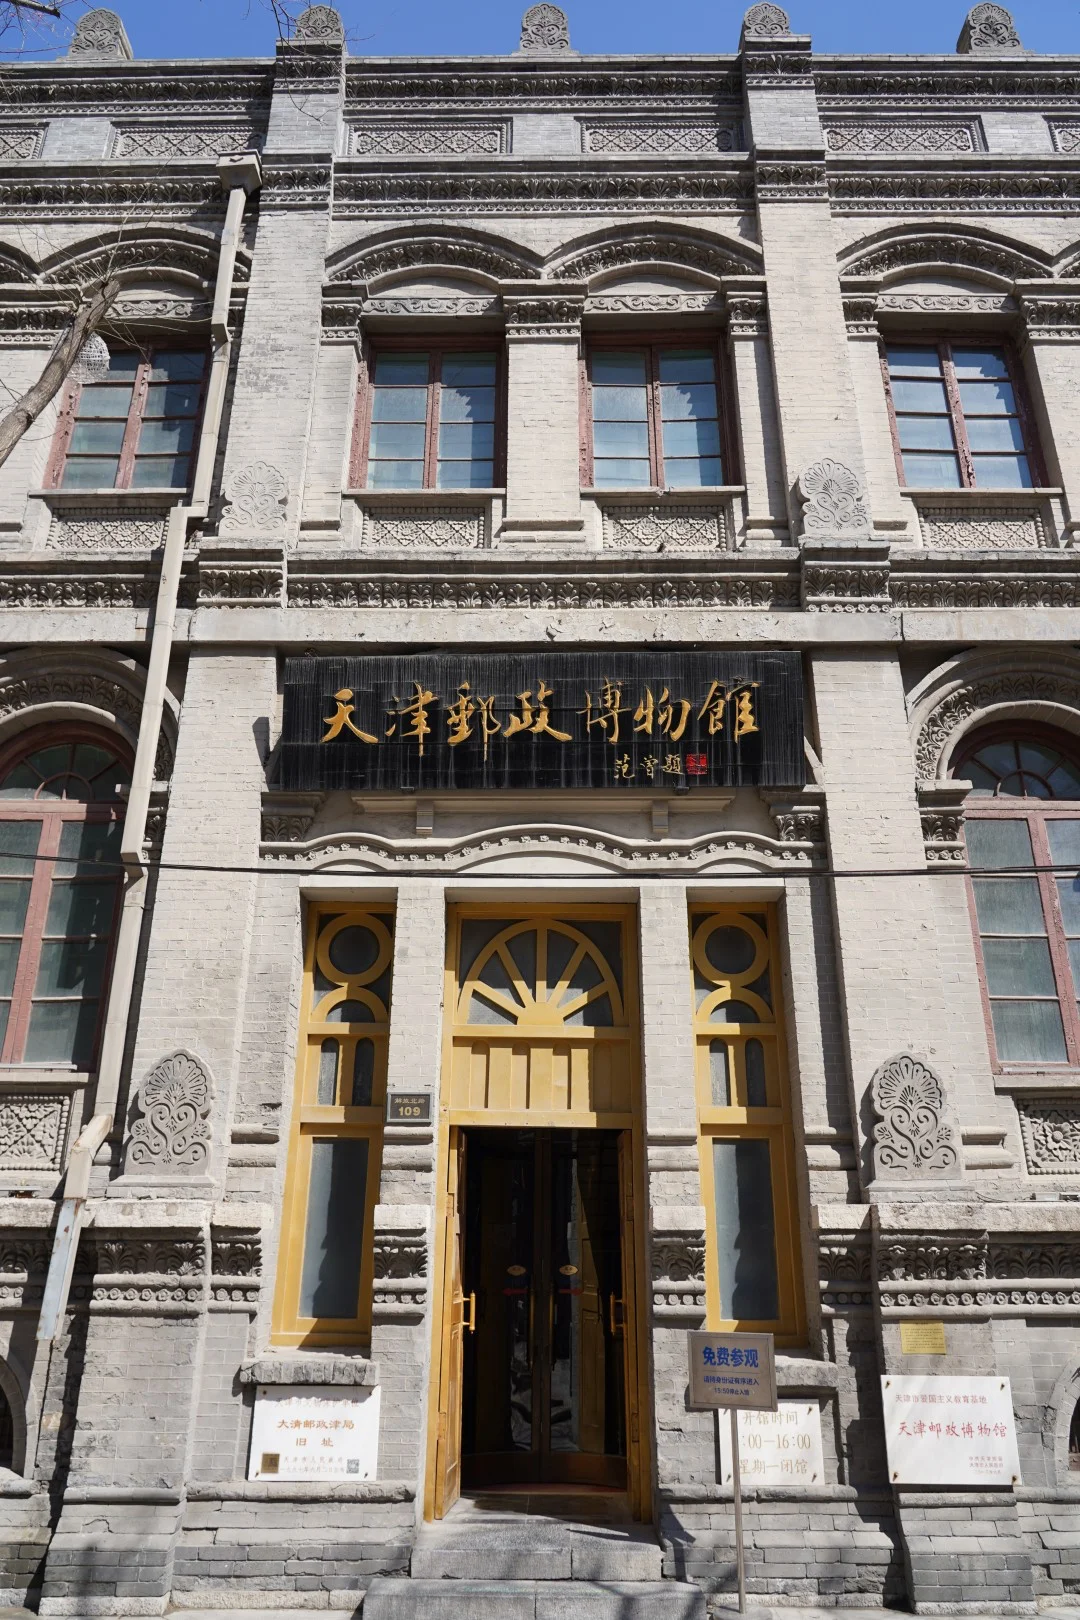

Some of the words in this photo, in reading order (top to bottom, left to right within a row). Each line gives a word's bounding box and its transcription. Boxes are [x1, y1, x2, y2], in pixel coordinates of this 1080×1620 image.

[398, 1106, 421, 1116] 109
[703, 1346, 759, 1368] 免费参观
[278, 1419, 355, 1430] 大清邮政津局
[742, 1410, 799, 1426] 开馆时间
[897, 1420, 1008, 1440] 天津邮政博物馆
[740, 1458, 809, 1475] 星期一闭馆
